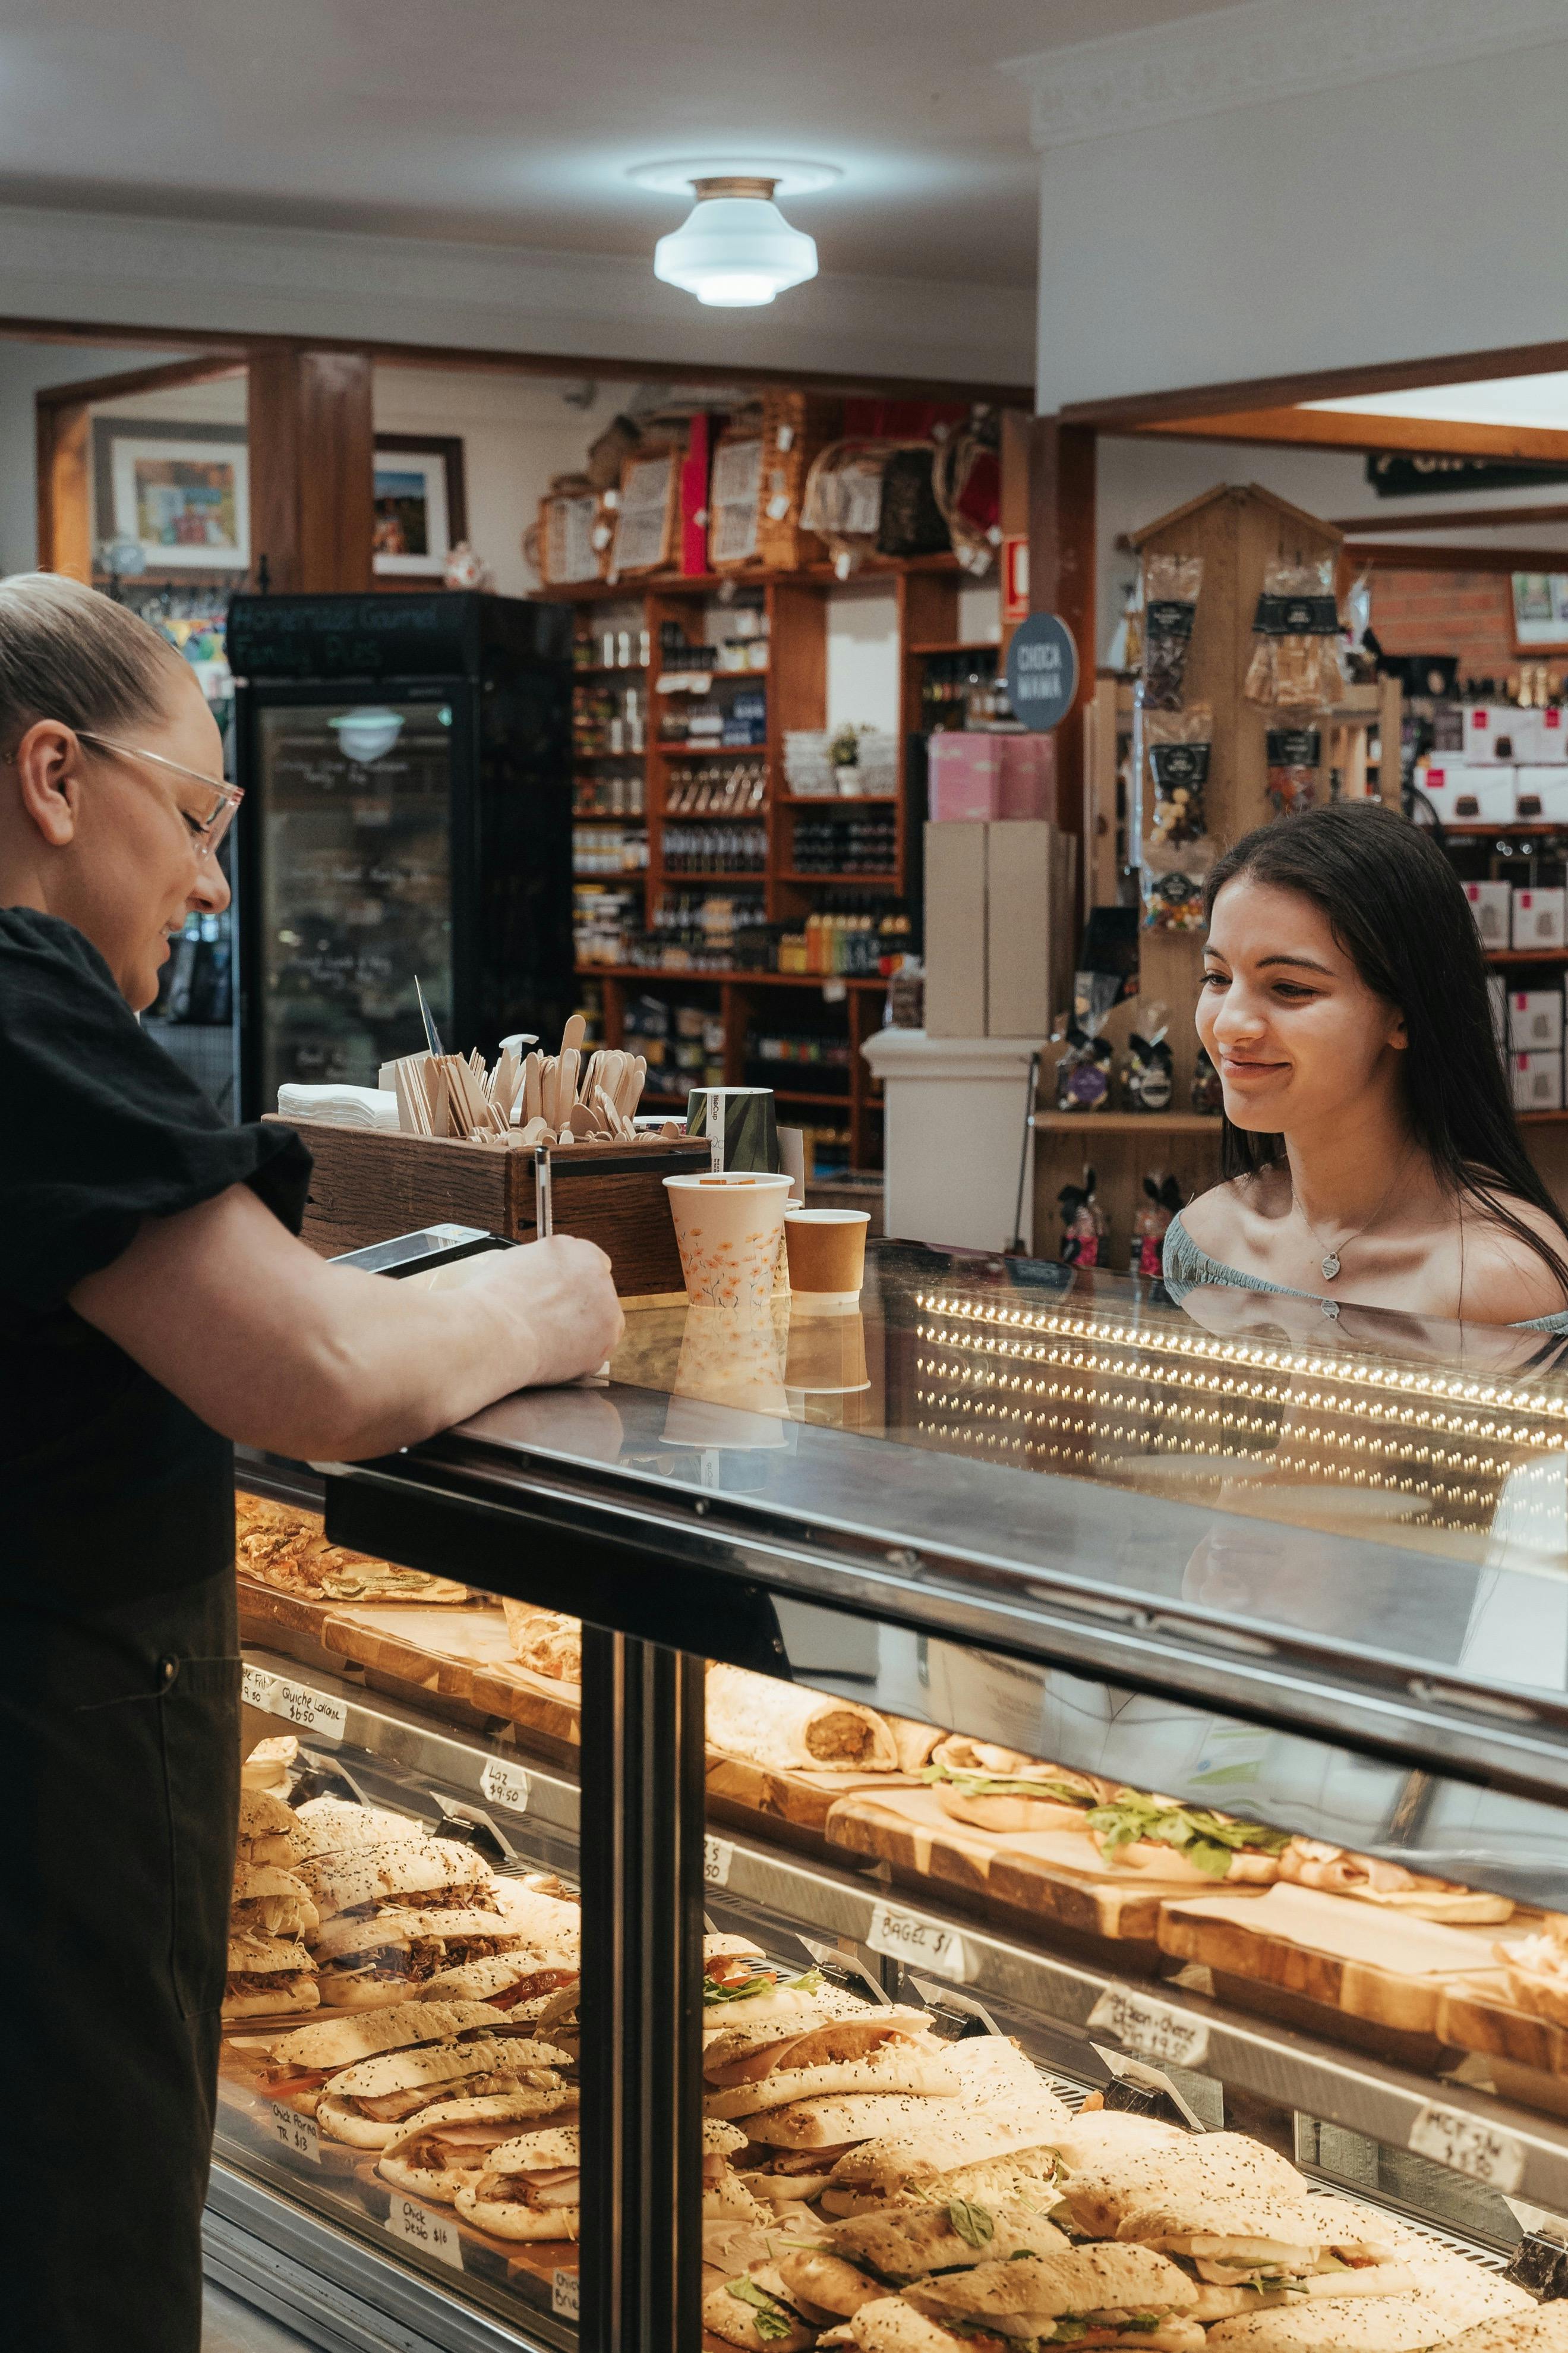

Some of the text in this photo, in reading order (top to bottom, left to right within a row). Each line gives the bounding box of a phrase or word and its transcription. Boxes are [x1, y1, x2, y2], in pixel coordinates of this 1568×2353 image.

[282, 1687, 312, 1708] Quiche
[490, 1783, 519, 1801] $9.50
[882, 1917, 925, 1945] BAGEL
[273, 2105, 291, 2124] Chick
[277, 2125, 308, 2151] TR $13
[403, 2202, 425, 2225] Chick
